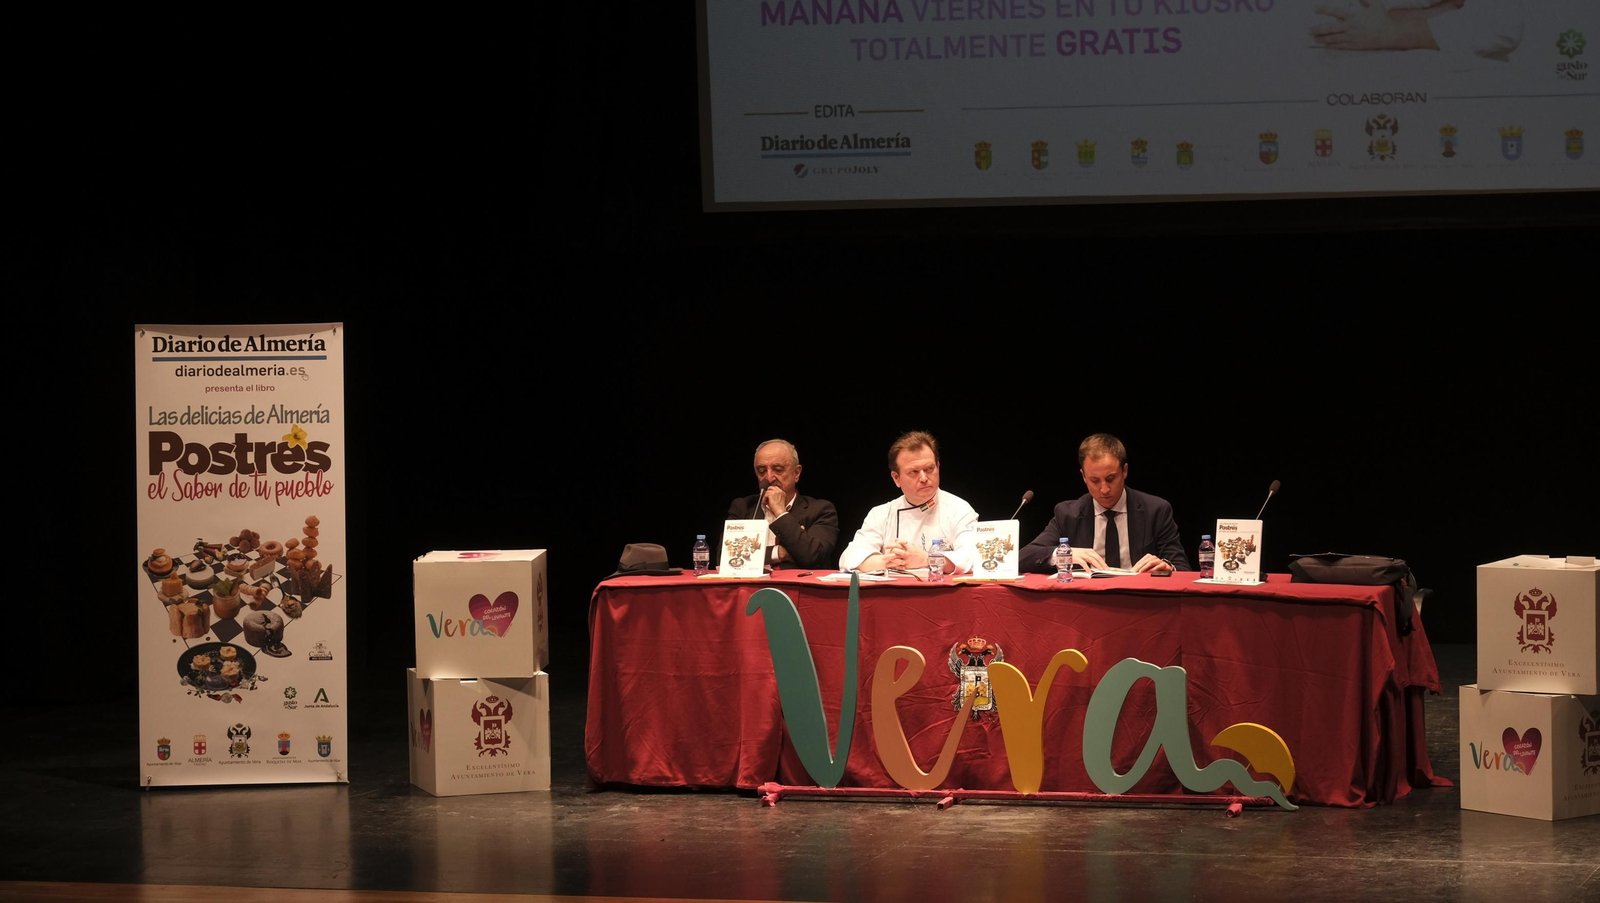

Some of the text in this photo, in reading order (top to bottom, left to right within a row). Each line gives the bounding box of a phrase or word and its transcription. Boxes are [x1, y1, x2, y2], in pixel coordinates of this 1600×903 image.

[910, 0, 1045, 22] VIERNES
[1056, 0, 1094, 18] EN
[851, 27, 1182, 62] TOTALMENTE GRATIS
[1326, 92, 1428, 107] COLABORAN
[814, 104, 855, 118] EDITA
[761, 132, 911, 151] Diario de Almería
[152, 334, 326, 353] Diario de Almería
[175, 365, 306, 377] diariodealmeria.es
[205, 384, 275, 393] presenta el libro
[149, 403, 330, 426] Las delicias de Almería
[149, 431, 332, 476] Postres
[148, 468, 334, 506] el Sabor de tu pueblo
[426, 611, 497, 639] Vera
[745, 572, 1299, 810] Vera
[1469, 741, 1524, 775] Vera
